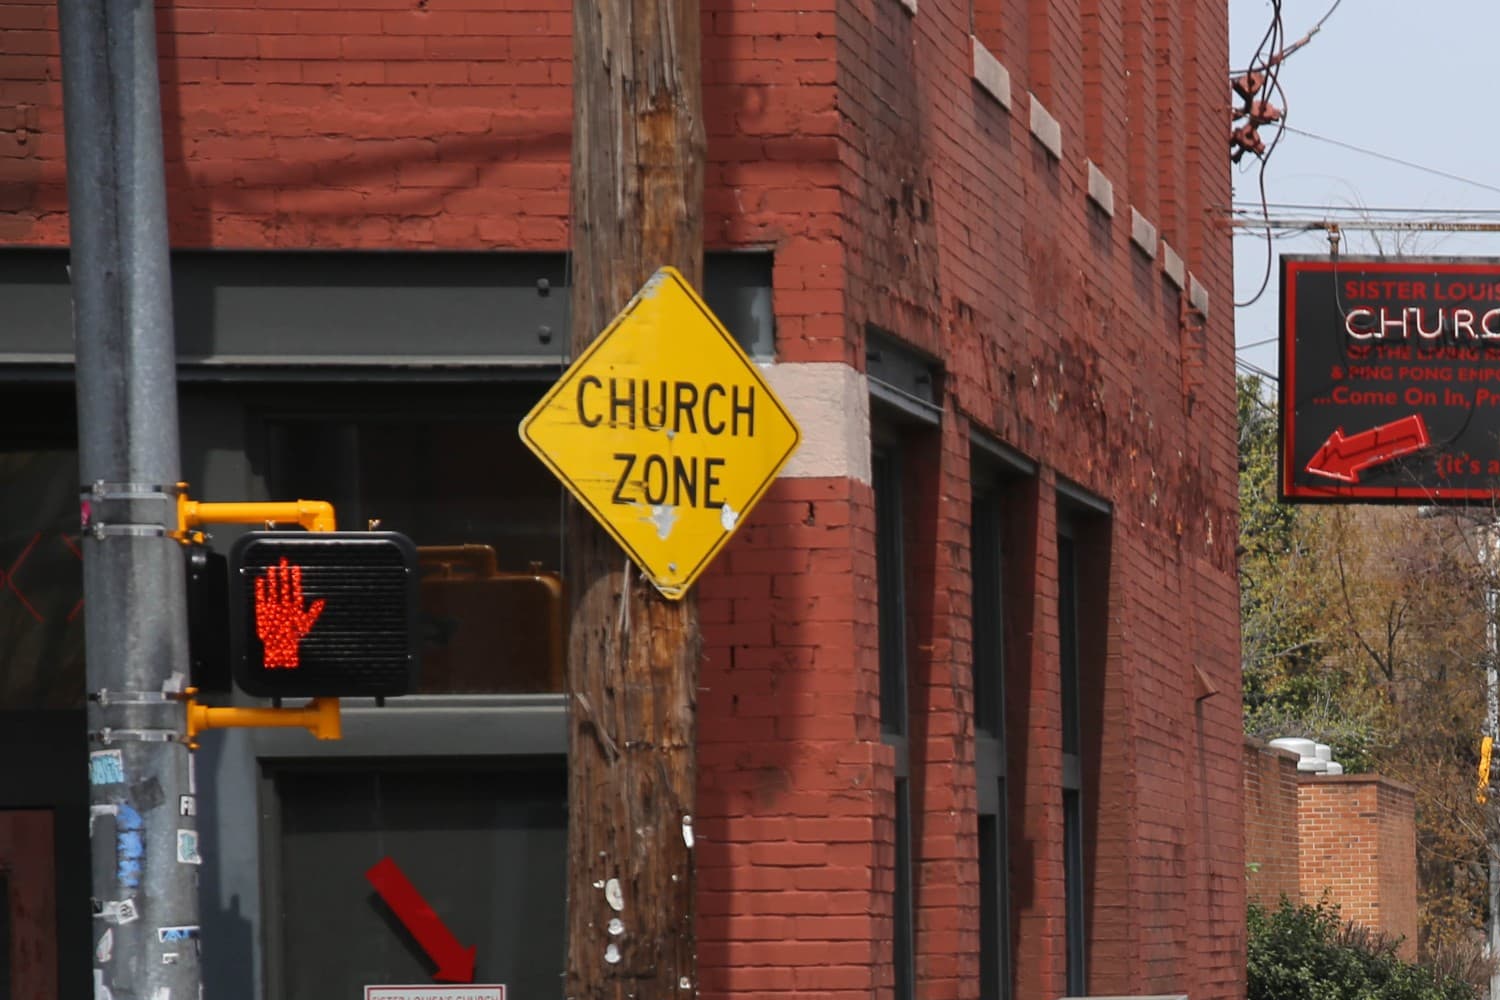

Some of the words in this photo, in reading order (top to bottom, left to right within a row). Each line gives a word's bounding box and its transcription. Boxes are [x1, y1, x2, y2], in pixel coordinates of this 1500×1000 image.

[1345, 281, 1427, 300] SISTER
[1347, 344, 1369, 360] OF
[1372, 344, 1412, 361] THE
[1416, 345, 1479, 362] LIVING
[1331, 367, 1343, 380] &
[1349, 367, 1393, 381] PING
[1400, 367, 1453, 381] PONG
[576, 374, 756, 438] CHURCH
[1404, 386, 1437, 405] On
[1444, 386, 1472, 409] In,
[1487, 459, 1500, 475] a
[611, 453, 726, 510] ZONE
